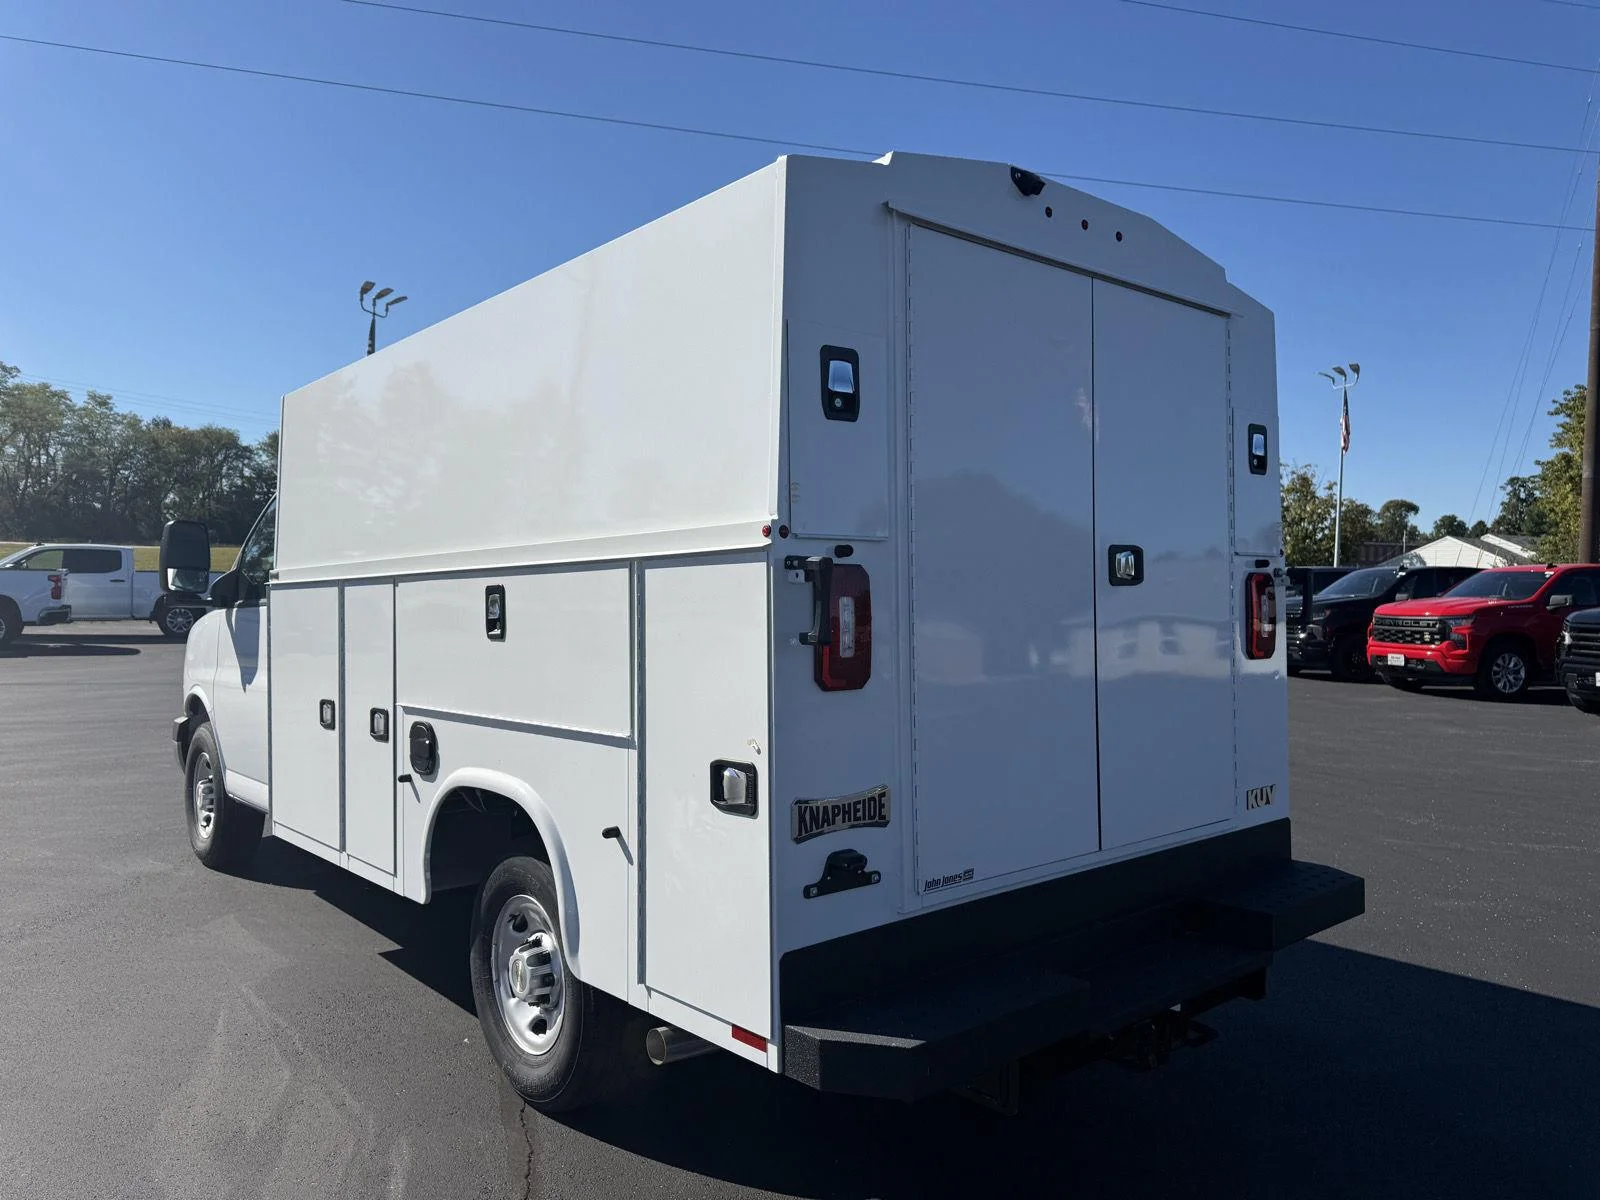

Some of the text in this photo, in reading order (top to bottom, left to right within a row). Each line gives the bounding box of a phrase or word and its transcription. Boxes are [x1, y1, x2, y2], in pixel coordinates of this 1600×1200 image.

[1246, 784, 1276, 810] KUV
[797, 791, 887, 837] KNAPHEIDE
[923, 877, 941, 892] John
[941, 873, 963, 888] Jones
